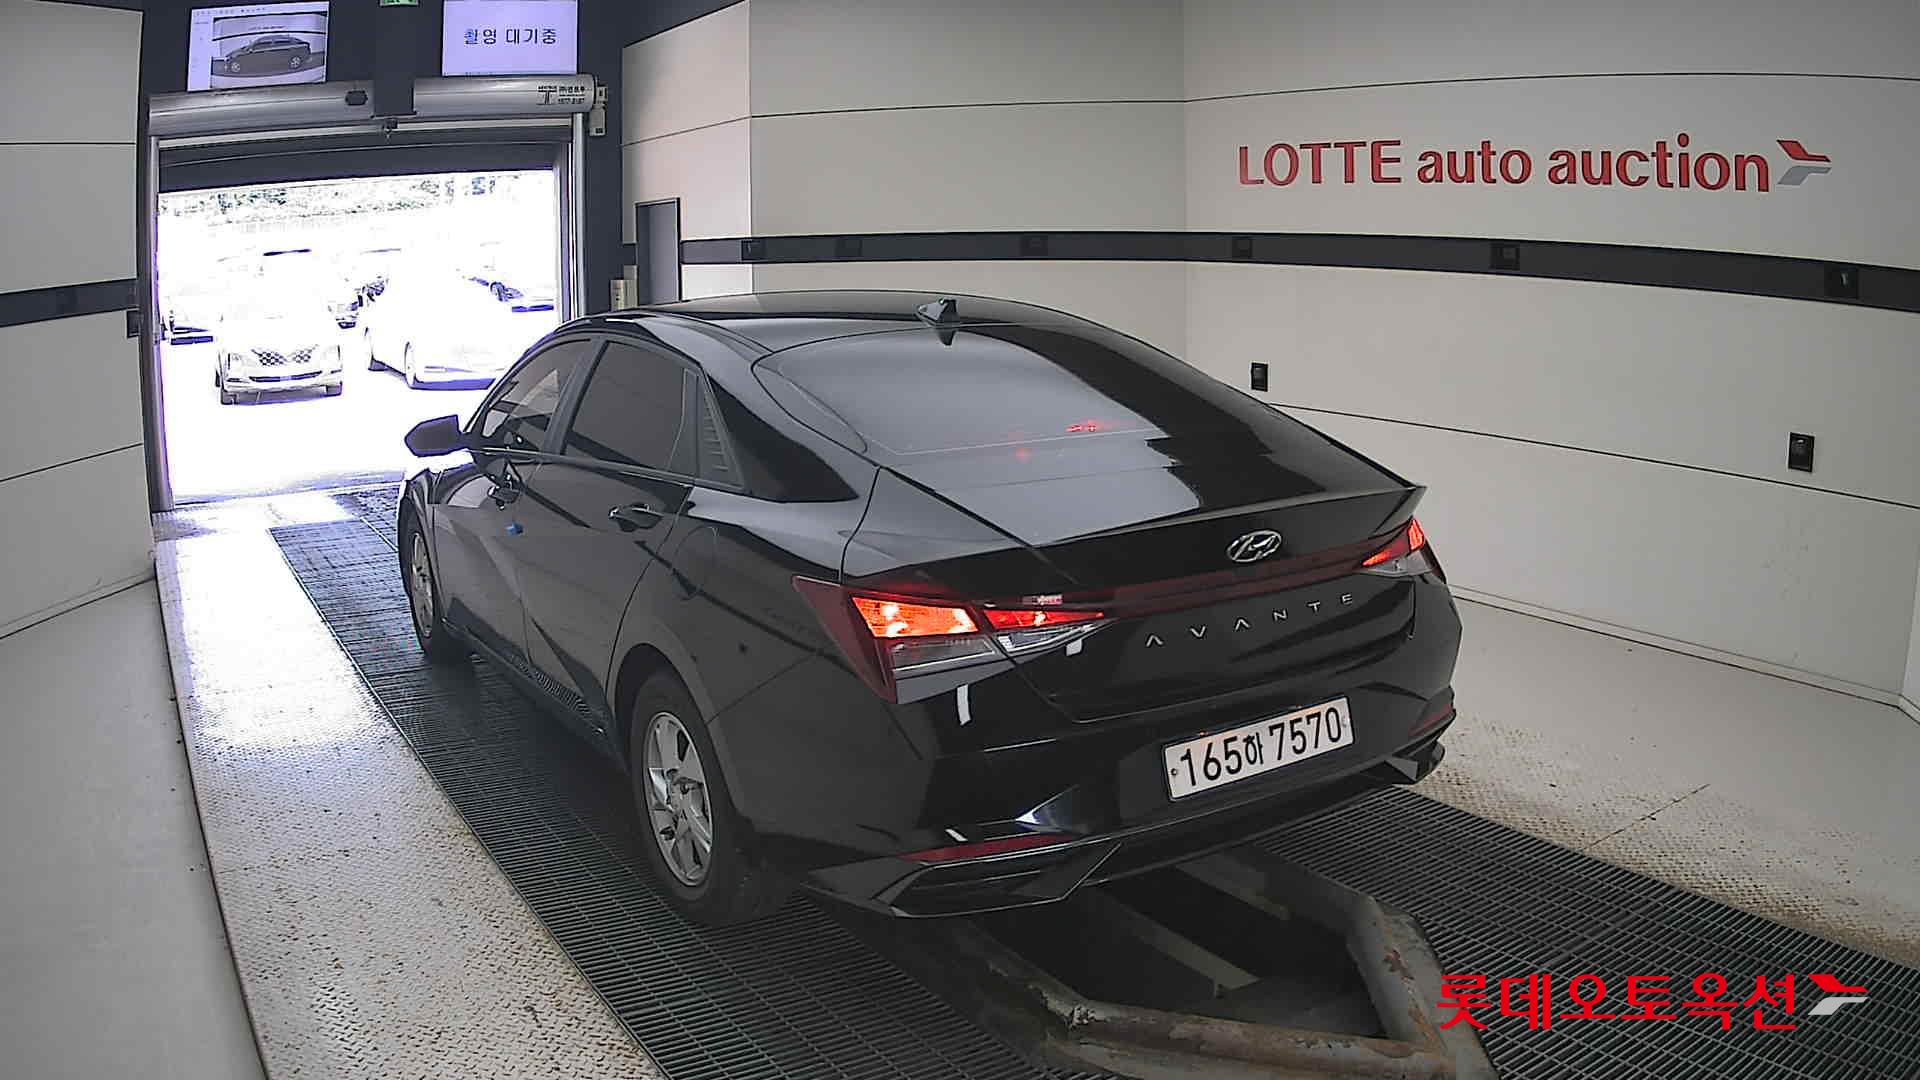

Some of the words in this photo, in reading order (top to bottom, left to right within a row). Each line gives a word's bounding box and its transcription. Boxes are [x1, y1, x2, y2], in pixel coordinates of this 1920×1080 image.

[505, 28, 556, 45] 대기중
[1239, 139, 1402, 186] LOTTE
[1417, 140, 1532, 184] auto
[1548, 132, 1769, 192] auction
[1146, 593, 1353, 648] AVANTE
